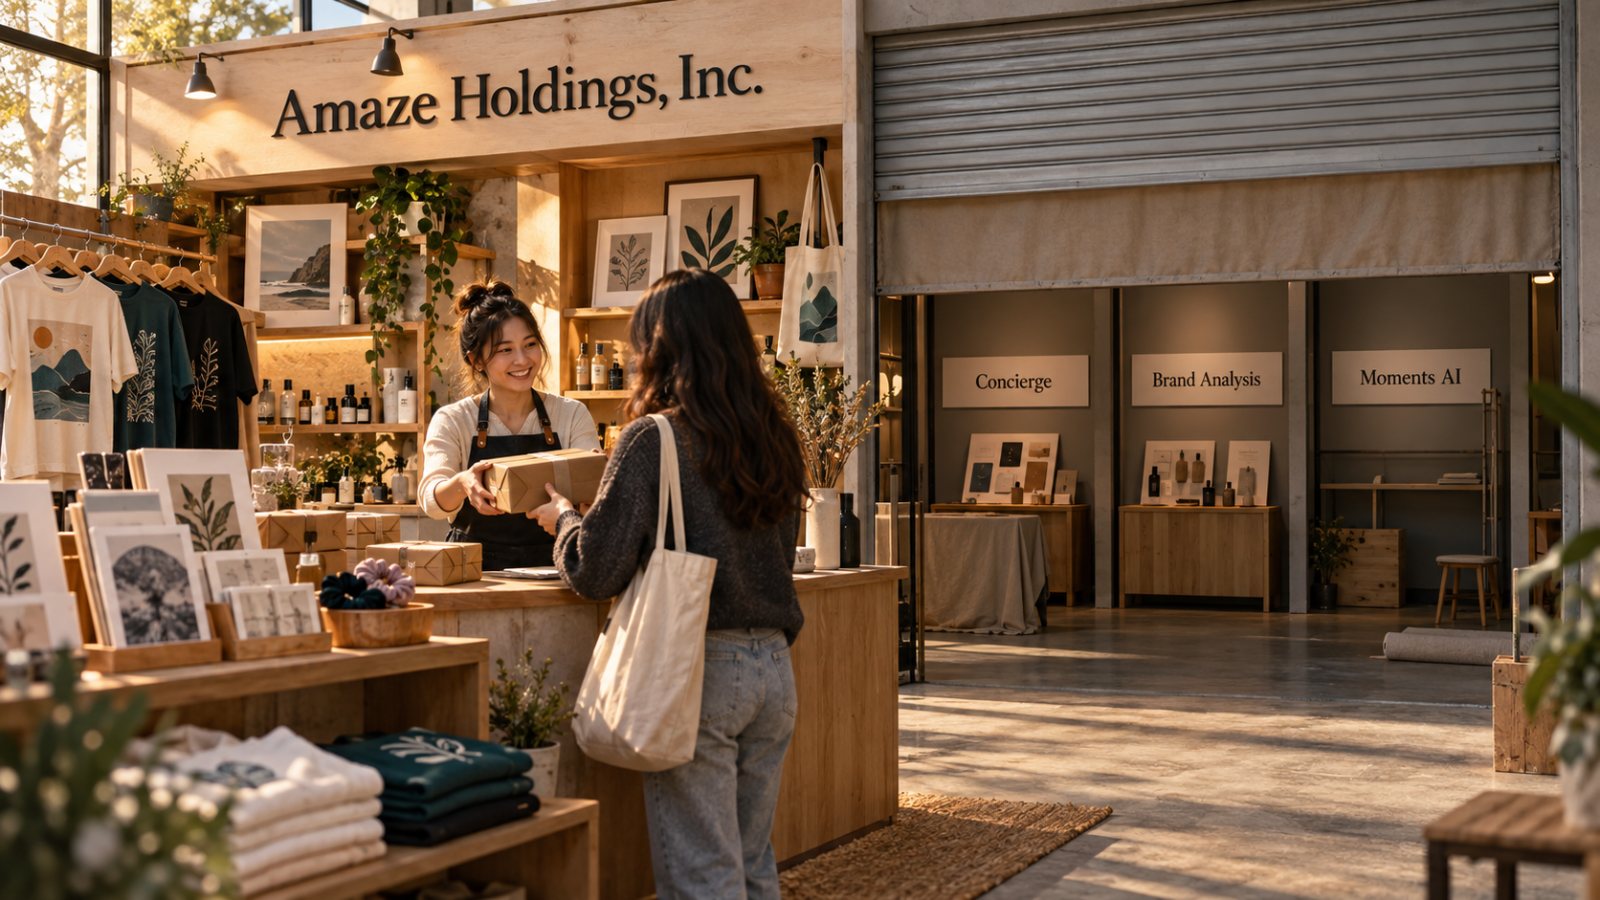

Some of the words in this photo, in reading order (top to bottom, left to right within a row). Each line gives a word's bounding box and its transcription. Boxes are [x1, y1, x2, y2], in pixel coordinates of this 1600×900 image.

[271, 89, 438, 138] Amaze
[450, 65, 669, 121] Holdings,
[678, 53, 764, 101] Inc.
[975, 373, 1052, 394] Concierge
[1152, 371, 1196, 388] Brand
[1200, 370, 1262, 392] Analysis
[1360, 369, 1436, 386] Moments
[1441, 368, 1462, 385] AI
